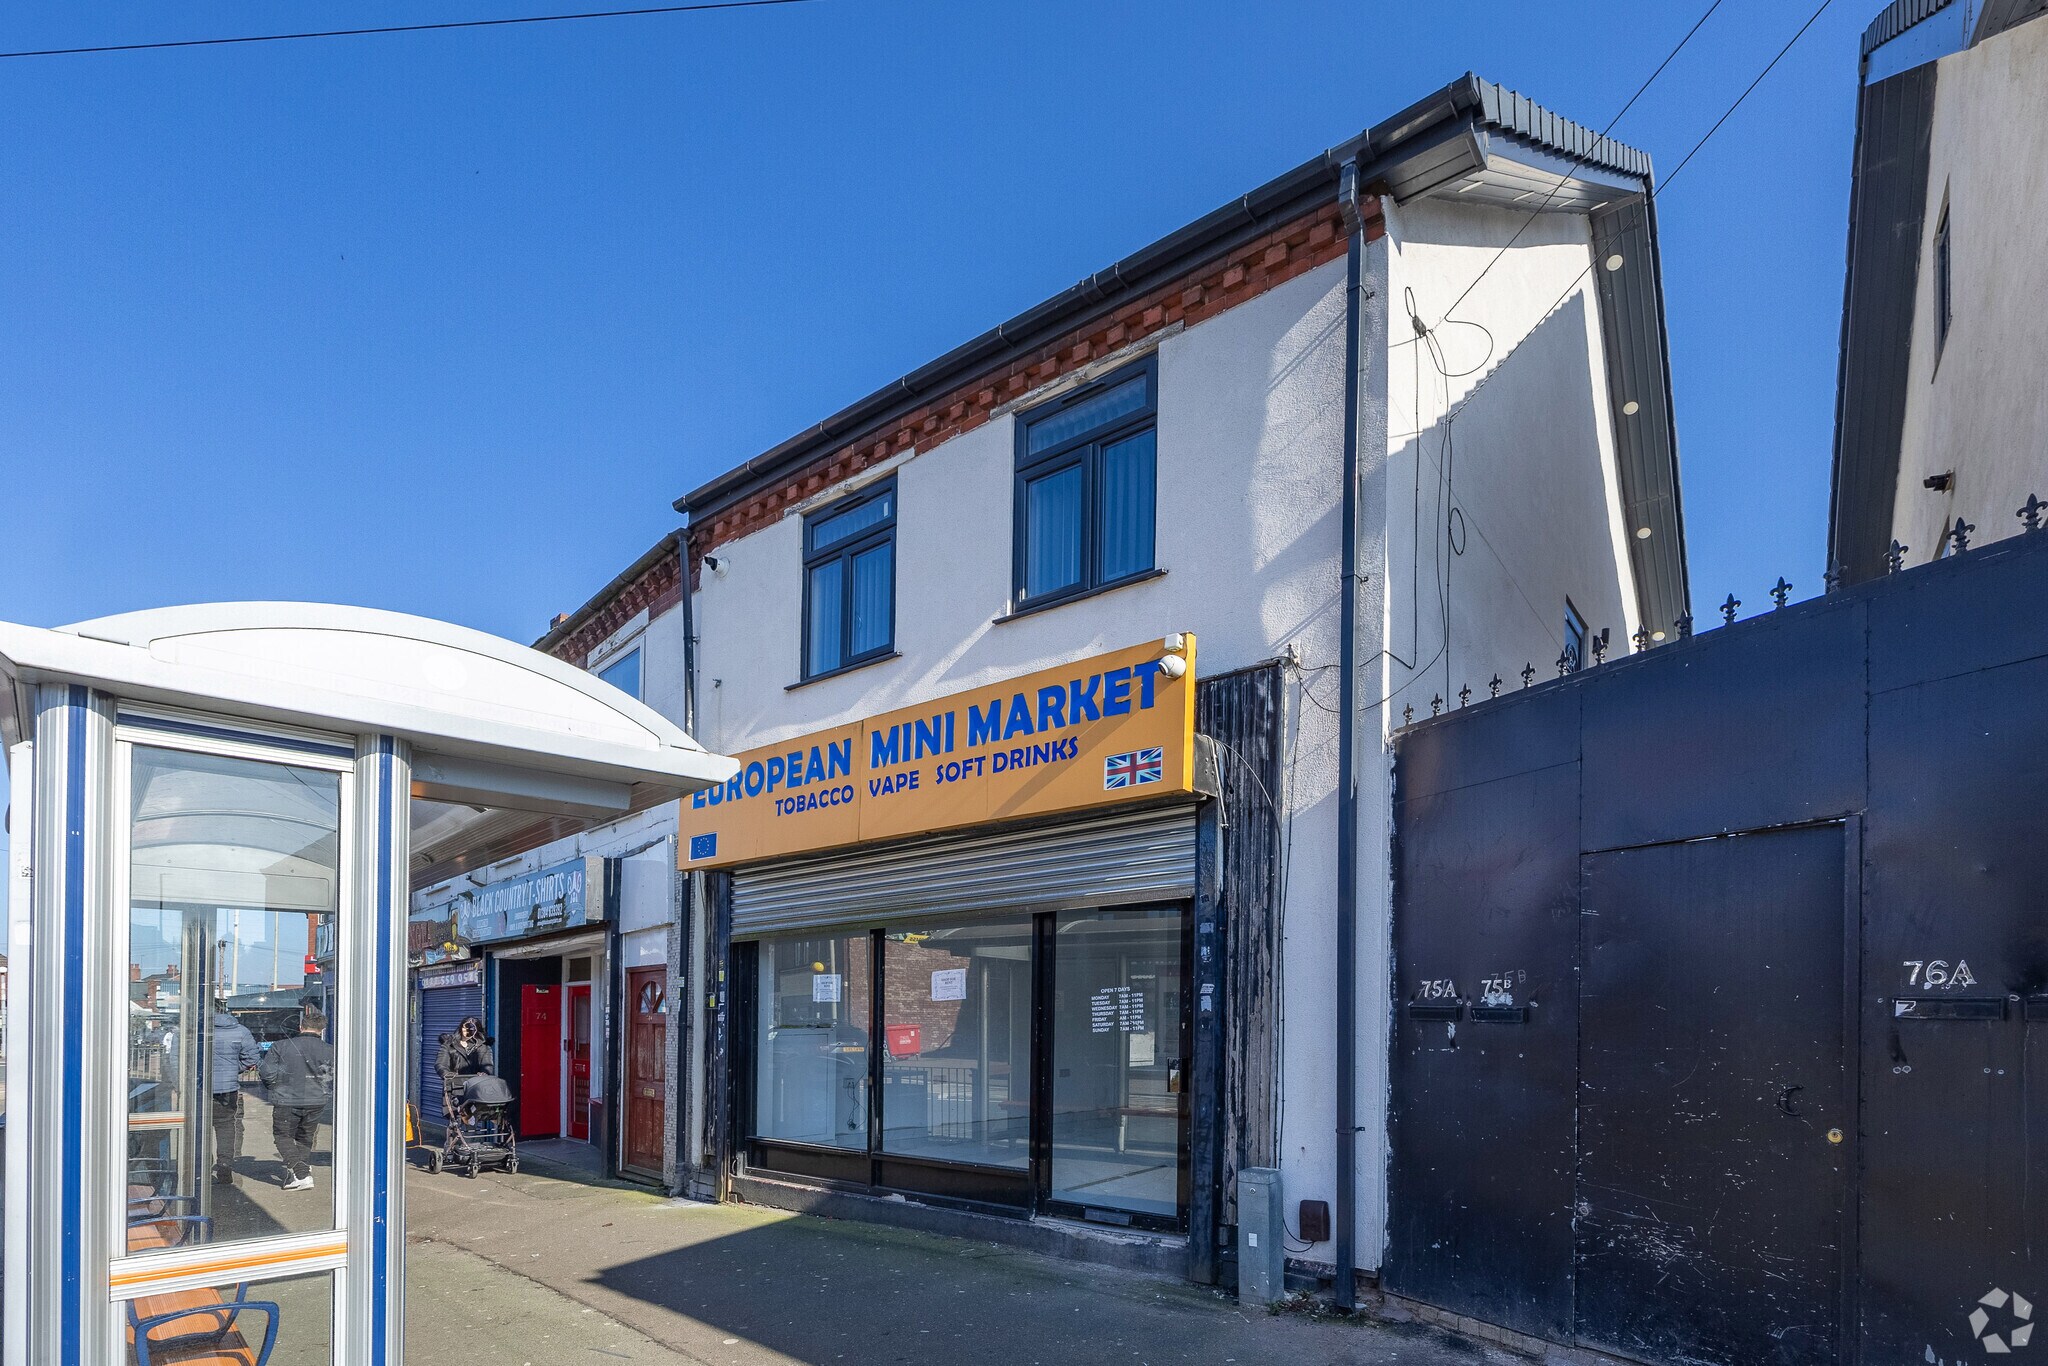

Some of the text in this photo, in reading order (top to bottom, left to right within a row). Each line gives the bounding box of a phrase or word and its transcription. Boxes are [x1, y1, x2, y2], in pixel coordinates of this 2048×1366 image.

[870, 711, 955, 769] MINI
[967, 659, 1161, 747] MARKET
[775, 736, 1079, 816] TOBACCO VAPE SOFT DRINKS
[472, 872, 565, 918] BLACK COUNTRY T-SHIRTS
[1421, 980, 1457, 998] 75A
[1481, 979, 1512, 998] 75B
[1903, 959, 1978, 985] 76A
